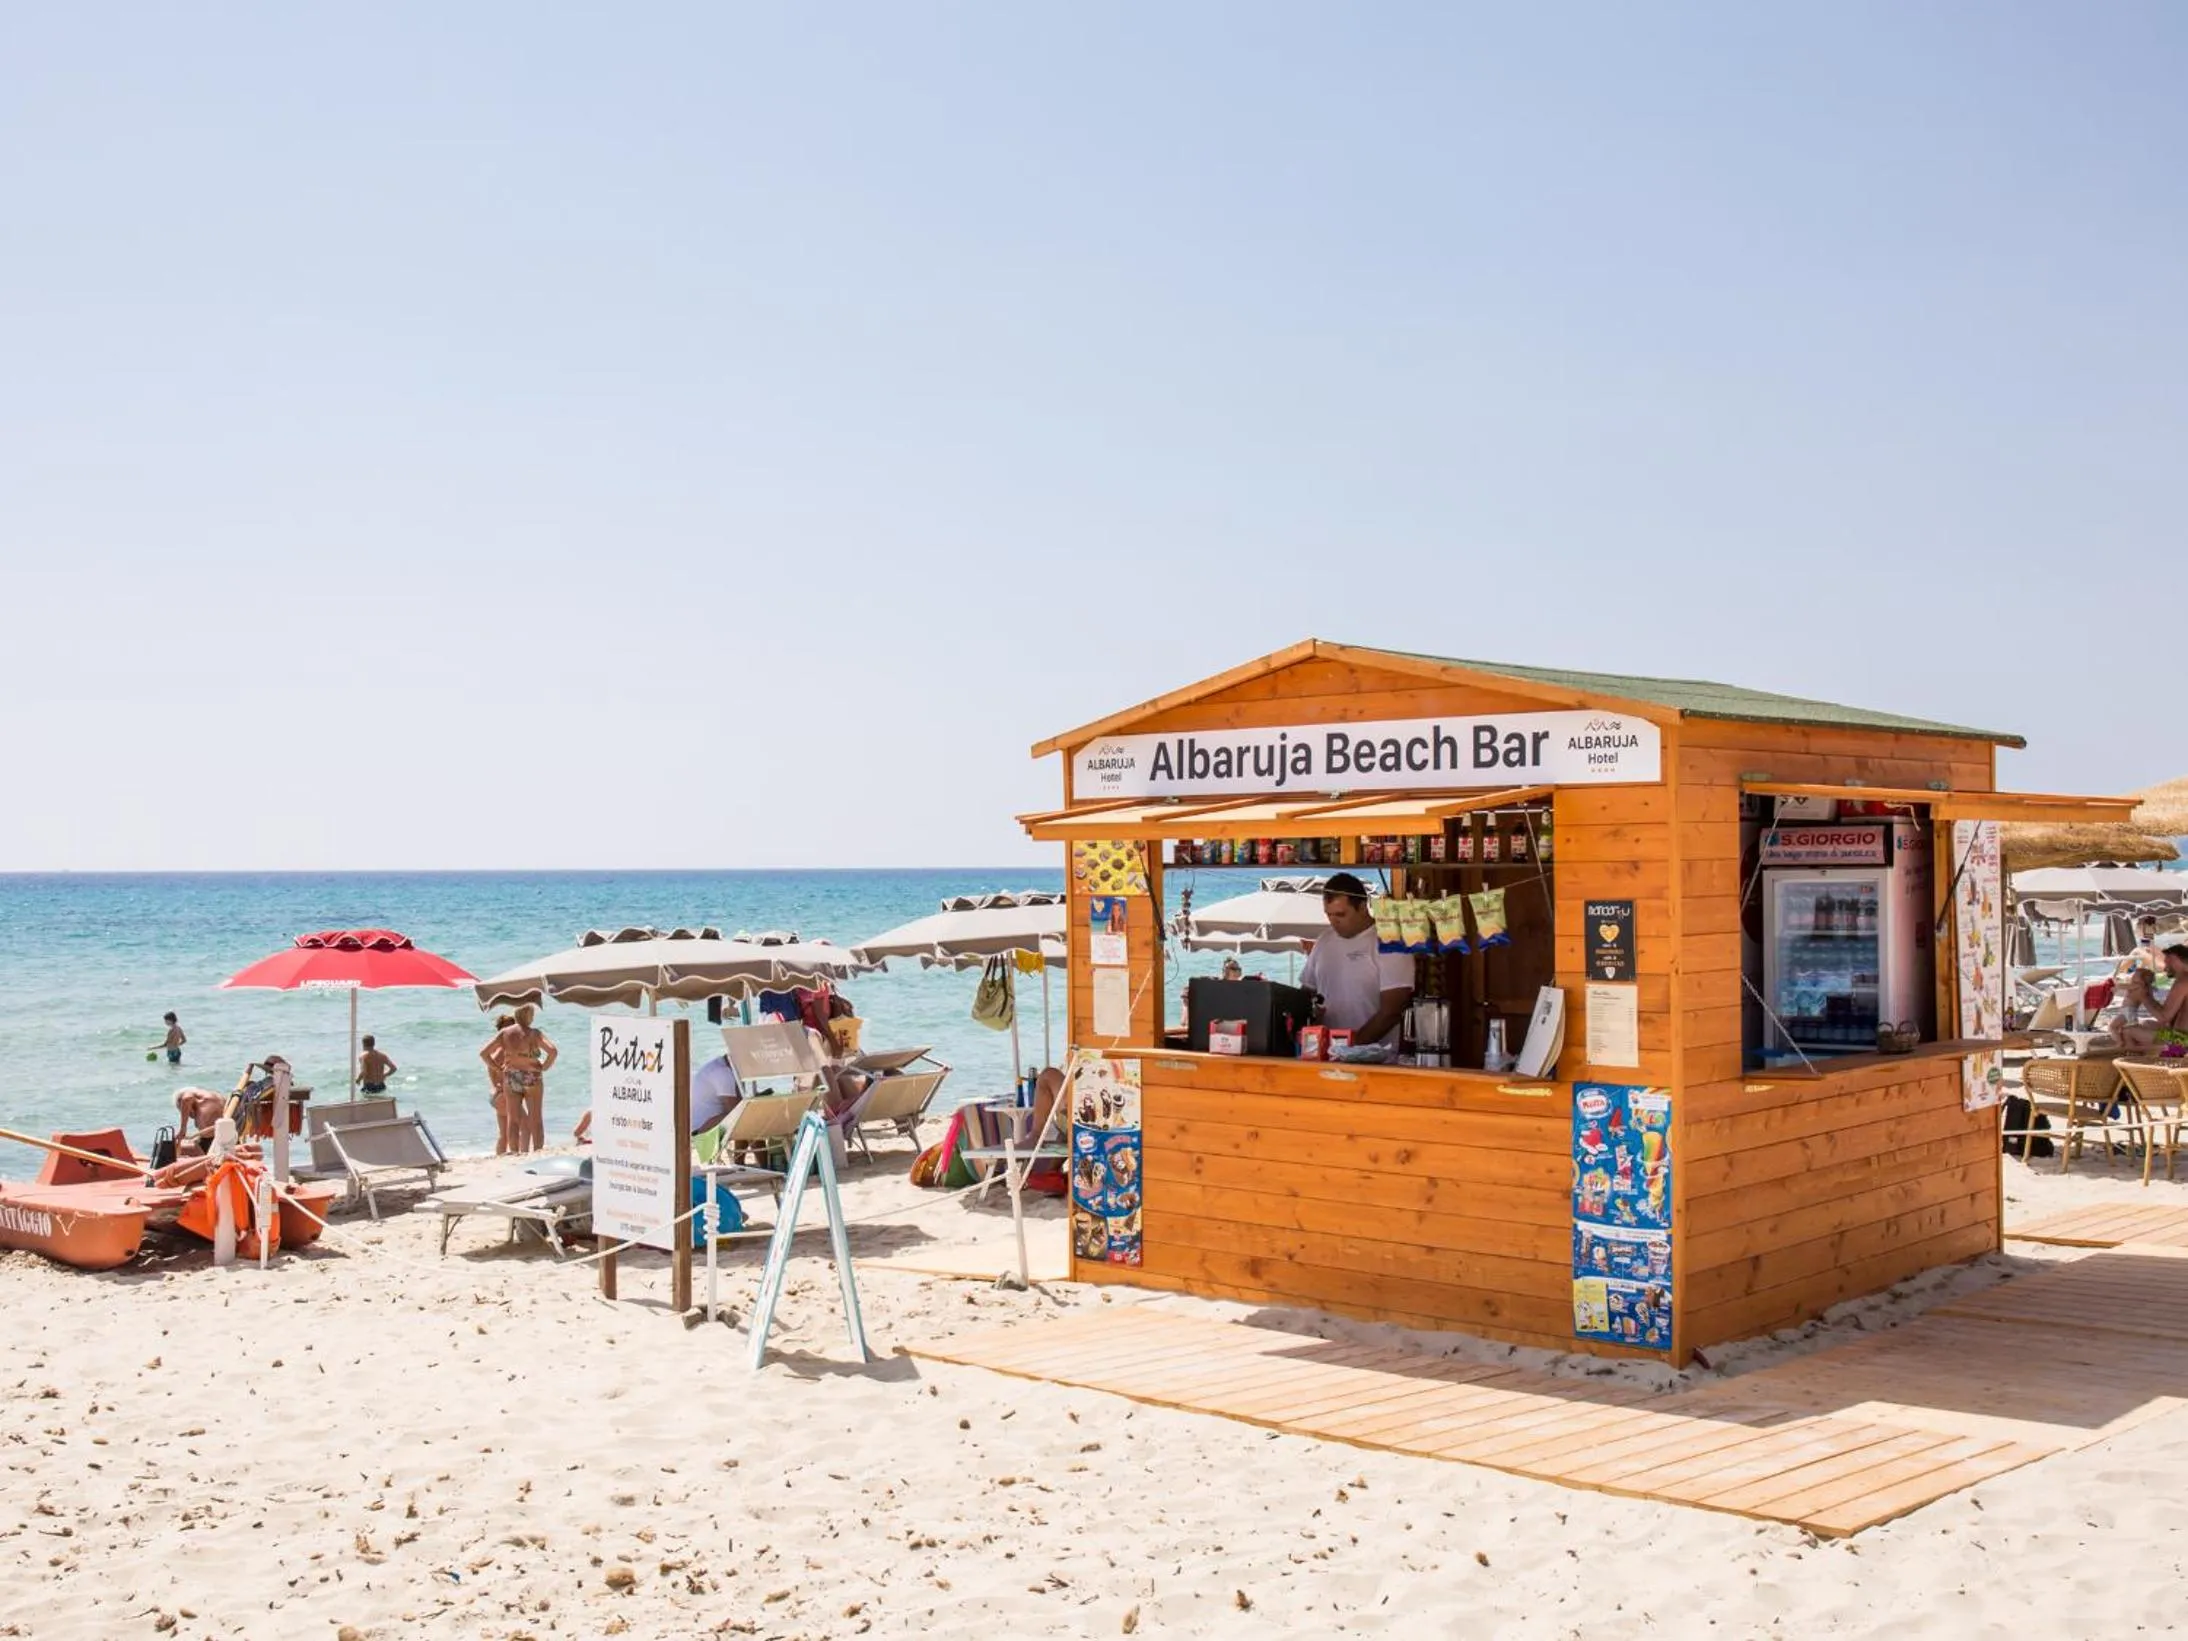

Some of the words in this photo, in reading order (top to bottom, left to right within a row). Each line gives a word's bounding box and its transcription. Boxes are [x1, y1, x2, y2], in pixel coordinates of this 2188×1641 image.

[1568, 734, 1639, 750] ALBARUJA
[1150, 732, 1312, 787] Albaruja
[1325, 725, 1458, 775] Beach
[1472, 724, 1549, 769] Bar
[1588, 752, 1618, 765] Hotel
[1087, 758, 1136, 772] ALBARUJA
[1100, 773, 1122, 783] Hotel
[1780, 832, 1876, 847] S.GIORGIO
[600, 1026, 664, 1073] Bistrot
[612, 1086, 653, 1103] ALBARUJA
